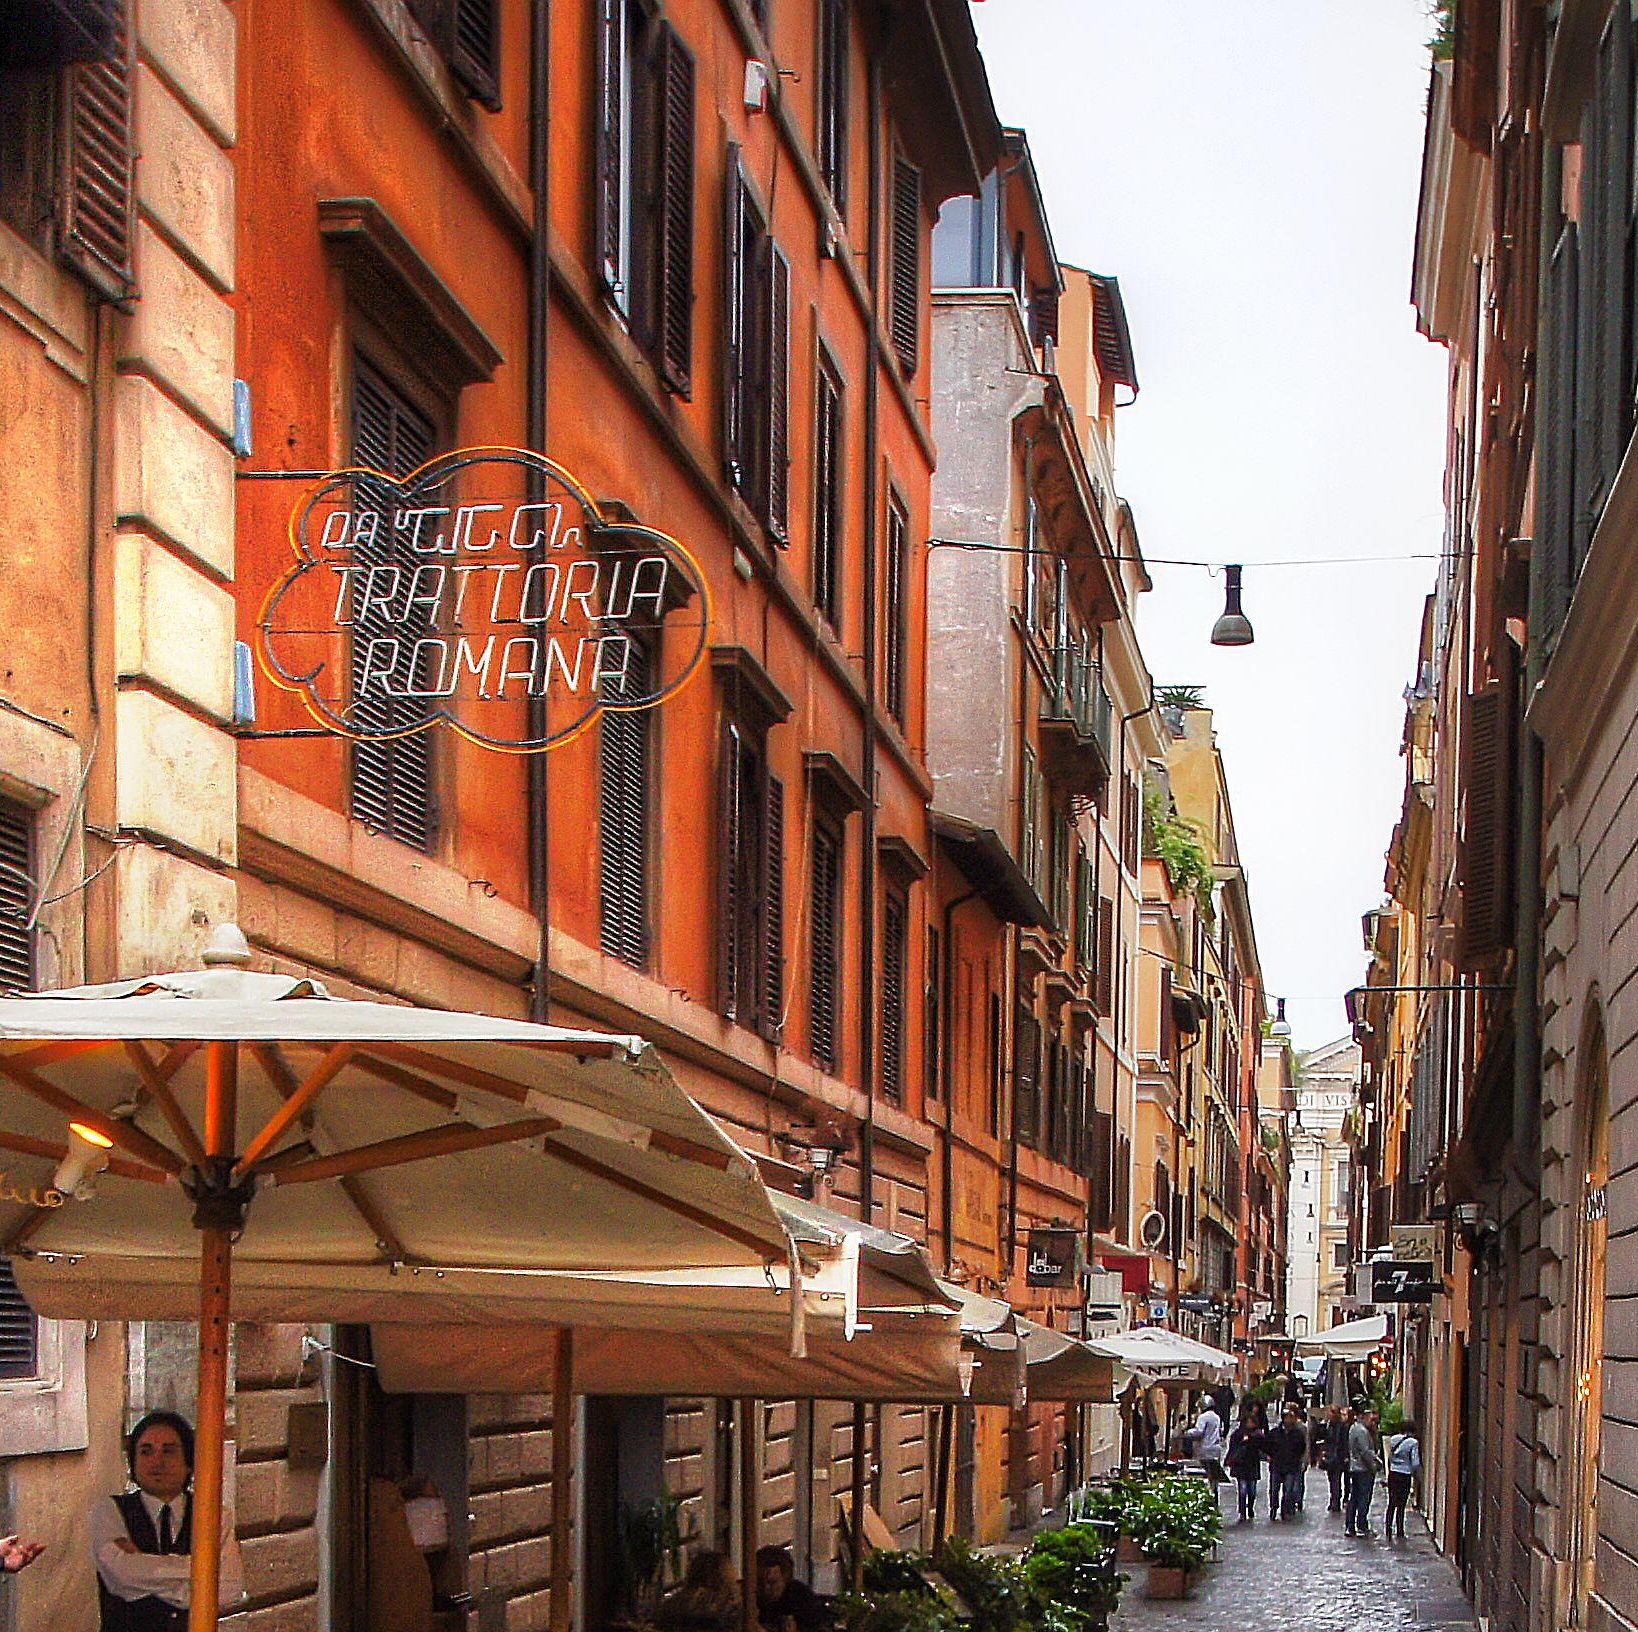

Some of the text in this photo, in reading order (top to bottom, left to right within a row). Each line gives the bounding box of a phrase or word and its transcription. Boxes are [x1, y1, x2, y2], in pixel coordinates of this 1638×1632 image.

[320, 511, 379, 548] DA
[331, 560, 668, 626] TRATTORIA
[361, 634, 631, 699] ROMANA
